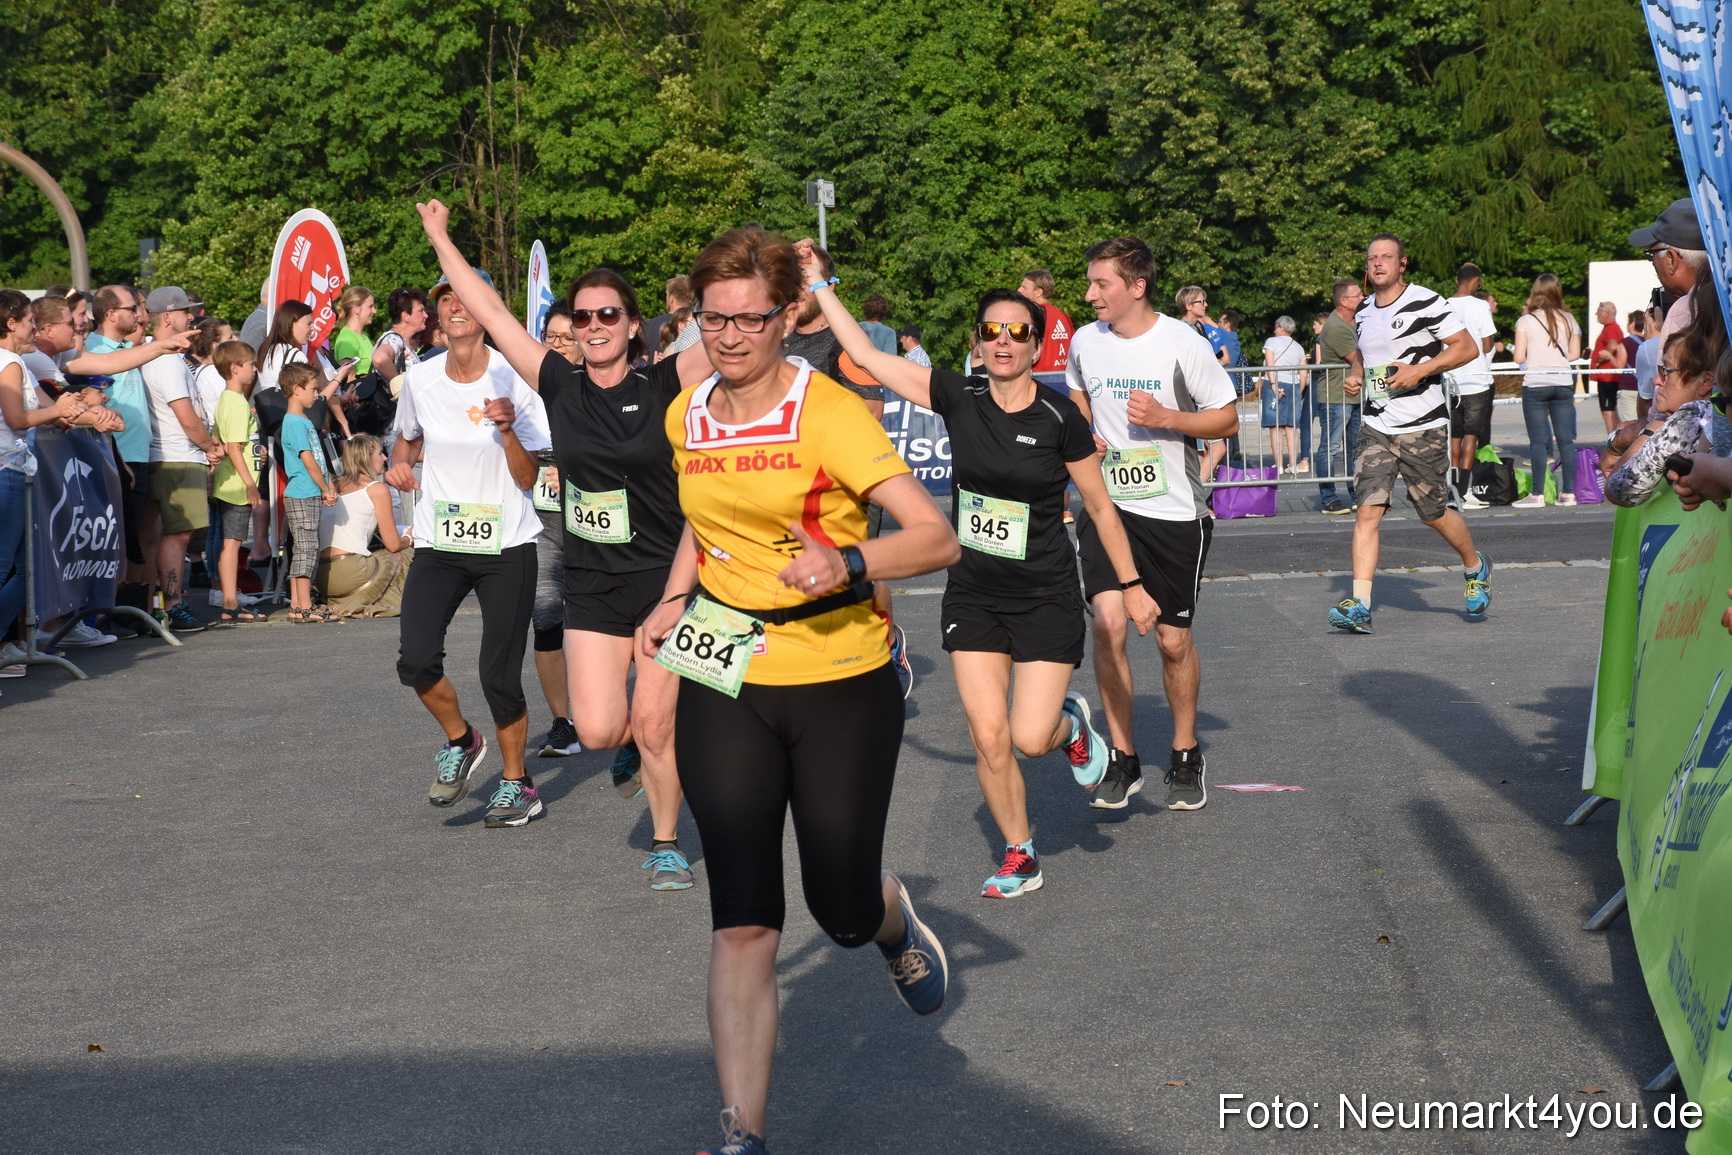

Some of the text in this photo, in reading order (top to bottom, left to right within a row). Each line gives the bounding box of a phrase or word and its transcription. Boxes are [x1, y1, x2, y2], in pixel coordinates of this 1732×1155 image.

[290, 235, 305, 267] AVIA
[1106, 378, 1162, 390] HAUBNER
[1371, 377, 1388, 391] 79
[1015, 434, 1037, 445] DOREEN
[685, 449, 802, 475] MAX BÖGL
[1110, 465, 1156, 485] 1008
[574, 505, 611, 529] 946
[970, 514, 1009, 541] 945
[442, 519, 492, 540] 1349
[984, 538, 1004, 546] Doreen
[676, 624, 736, 669] 684
[664, 653, 676, 664] Bögl
[676, 660, 706, 677] Bauservice
[707, 673, 724, 684] GmbH
[700, 660, 722, 677] Lydia
